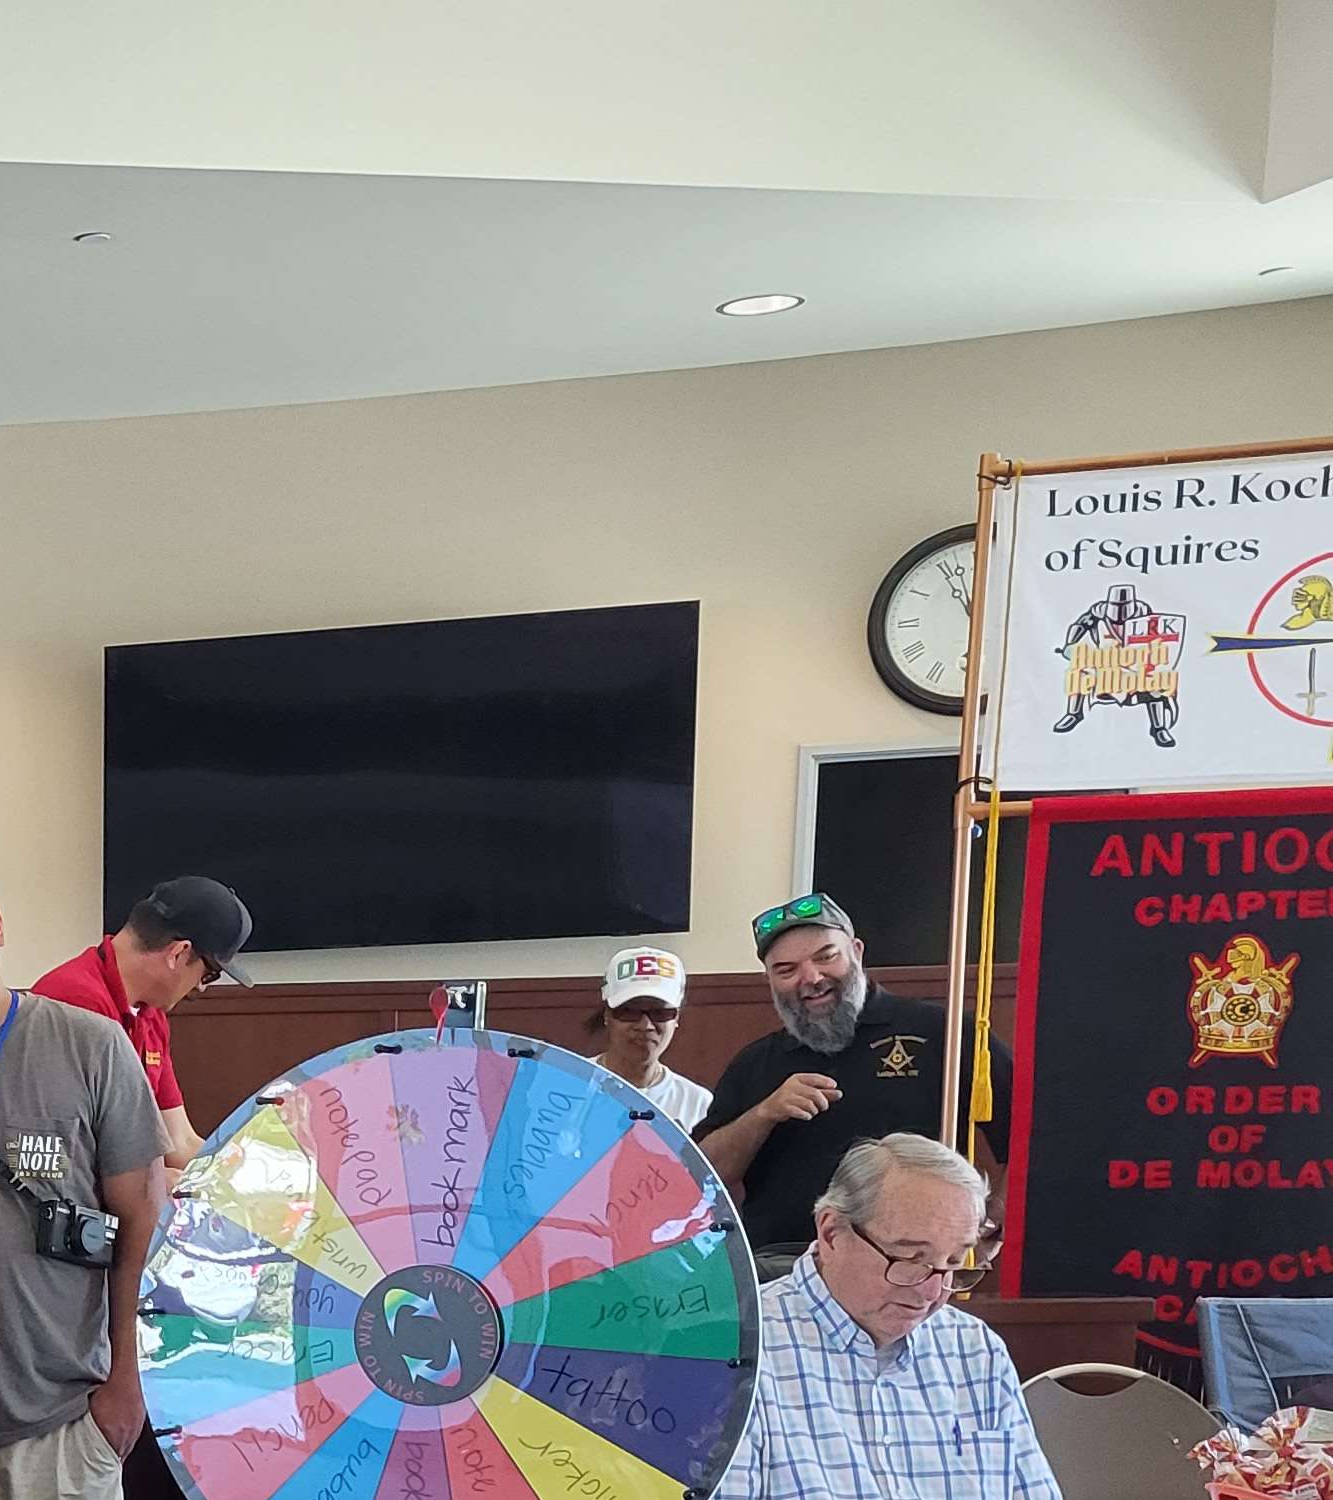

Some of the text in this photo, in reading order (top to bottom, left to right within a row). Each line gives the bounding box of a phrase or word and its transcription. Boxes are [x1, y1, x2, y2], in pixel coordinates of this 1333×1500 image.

[1046, 483, 1162, 518] Louis
[1173, 478, 1216, 510] R.
[1044, 535, 1260, 575] of Squires
[617, 956, 677, 980] OES
[1146, 1085, 1322, 1115] ORDER
[22, 1135, 64, 1153] HALF
[503, 1091, 586, 1198] bubbles
[1208, 1124, 1267, 1154] OF
[19, 1152, 62, 1171] NOTE
[1108, 1159, 1173, 1189] DE
[1112, 1244, 1333, 1290] ANTIOCH
[422, 1270, 496, 1360] SPIN TO WIN
[358, 1311, 425, 1402] SPIN TO WIN
